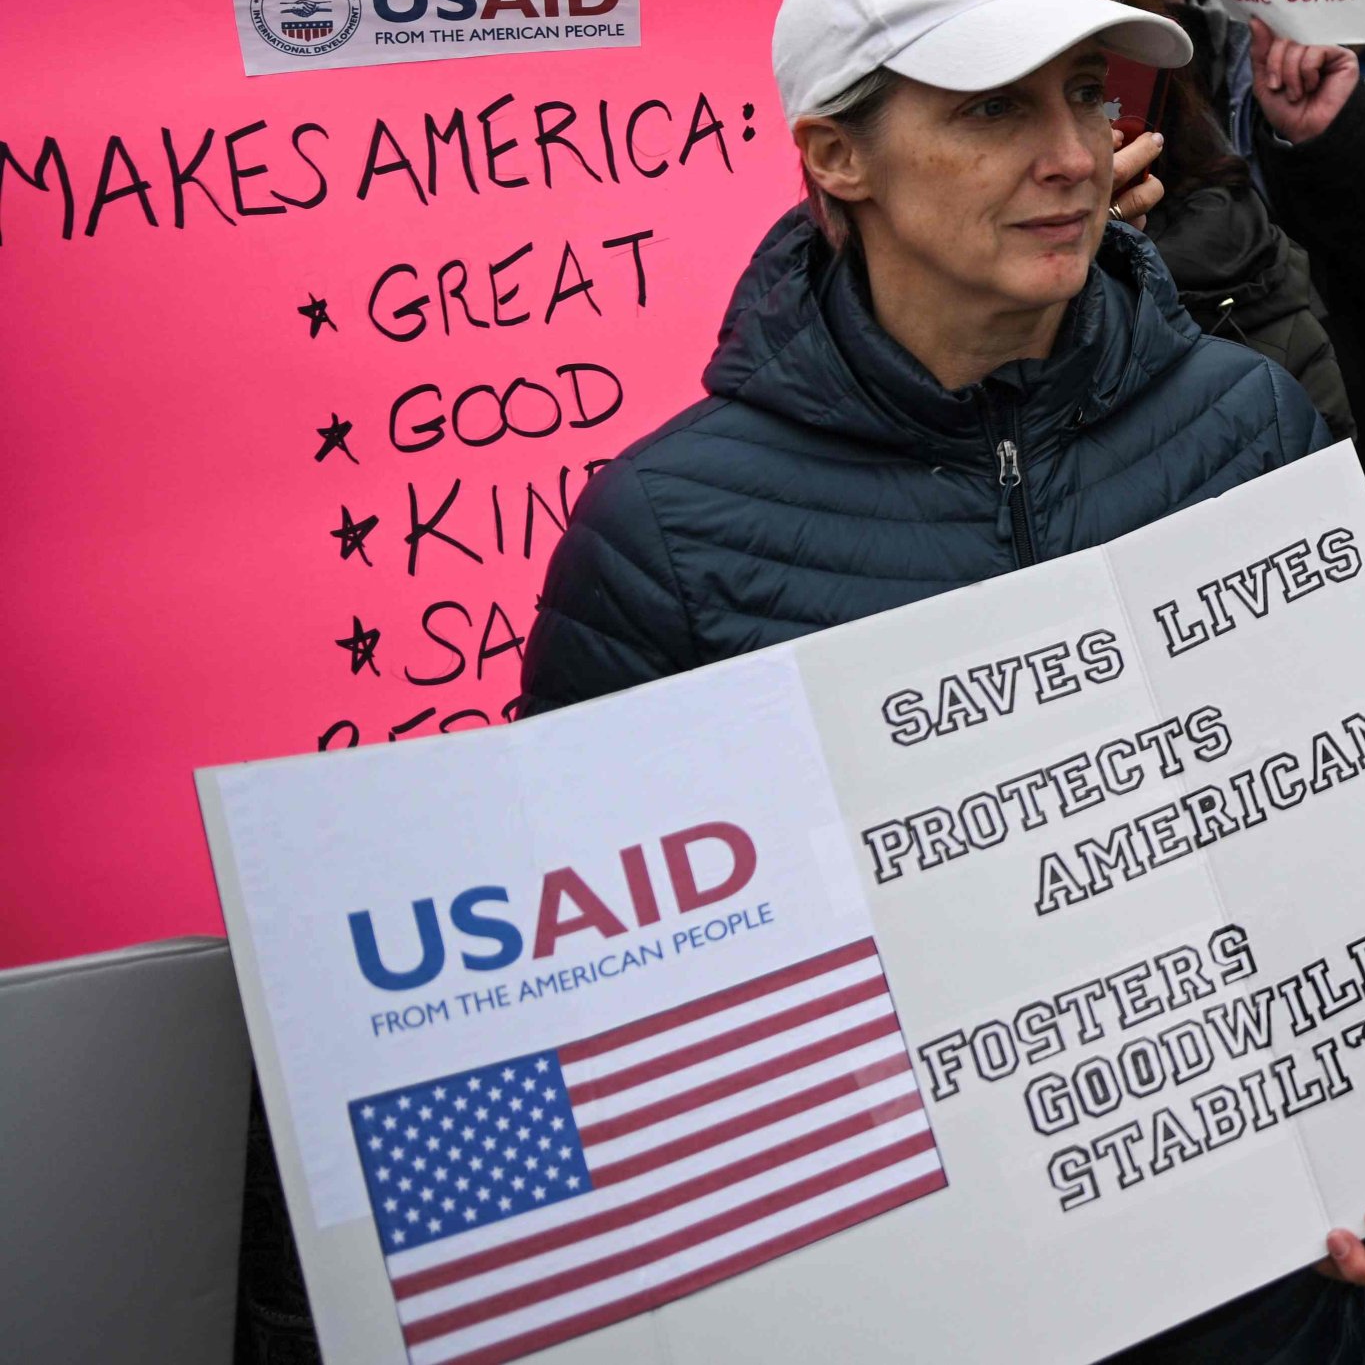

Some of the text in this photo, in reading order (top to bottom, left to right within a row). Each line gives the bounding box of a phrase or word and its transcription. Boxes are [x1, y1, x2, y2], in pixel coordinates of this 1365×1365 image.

[253, 6, 359, 54] INTERNATIONAL DEVELOPMENT
[374, 23, 625, 45] FROM THE AMERICAN PEOPLE
[0, 92, 757, 245] MAKES AMERICA:
[367, 230, 655, 342] GREAT
[389, 362, 624, 453] GOOD
[403, 458, 616, 576] KIN
[881, 527, 1364, 748] SAVES LIVES
[862, 705, 1233, 885] PROTECTS
[347, 820, 757, 992] USAID
[370, 902, 775, 1038] FROM THE AMERICAN PEOPLE
[917, 923, 1259, 1102] FOSTERS
